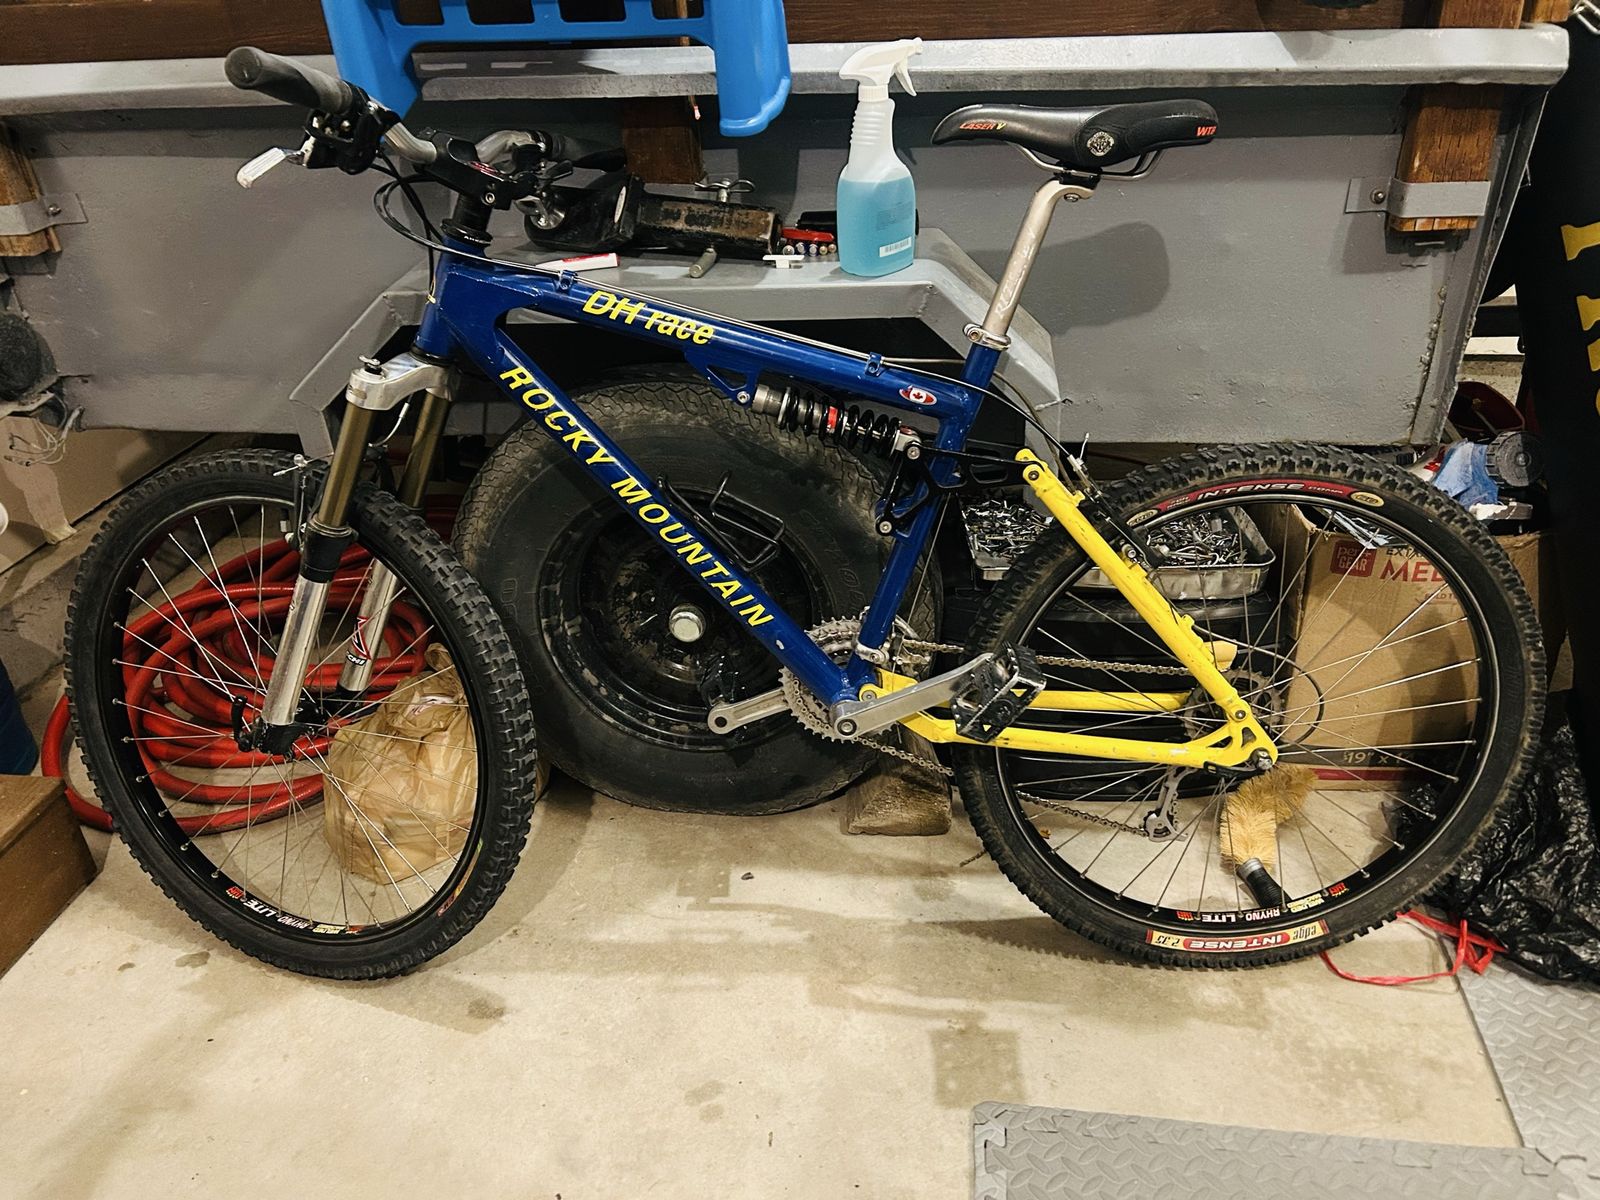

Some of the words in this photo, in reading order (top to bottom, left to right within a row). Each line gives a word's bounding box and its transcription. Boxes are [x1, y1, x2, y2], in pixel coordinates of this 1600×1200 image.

[582, 289, 645, 326] DH
[643, 309, 715, 346] race
[499, 366, 617, 466] ROCKY
[611, 475, 775, 628] MOUNTAIN
[1197, 482, 1305, 501] INTENSE
[1338, 555, 1368, 572] GEAR
[243, 899, 277, 918] LITE
[1245, 908, 1281, 922] RHYNO
[1202, 914, 1236, 923] LITE
[1189, 934, 1282, 949] INTENSE
[1293, 924, 1317, 942] edge
